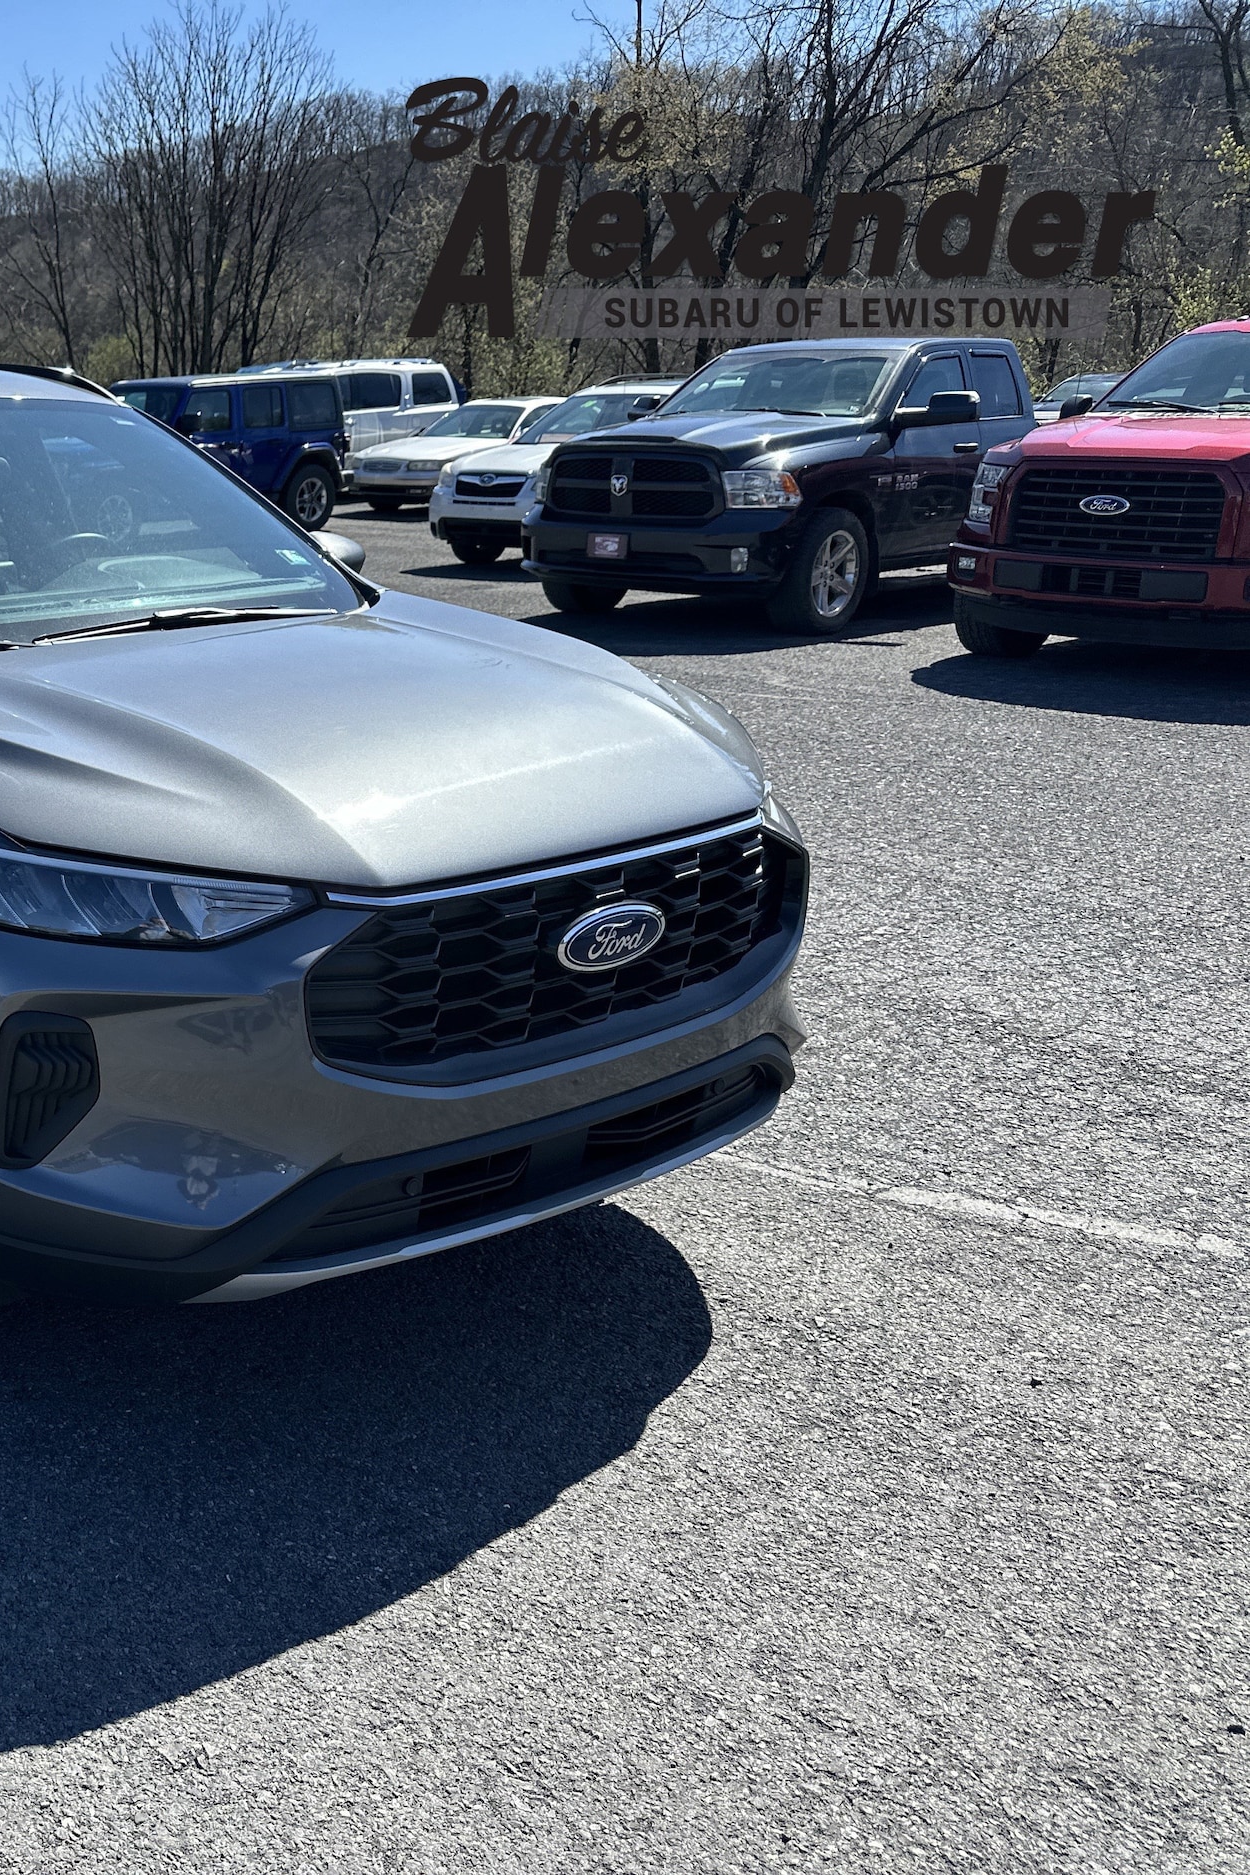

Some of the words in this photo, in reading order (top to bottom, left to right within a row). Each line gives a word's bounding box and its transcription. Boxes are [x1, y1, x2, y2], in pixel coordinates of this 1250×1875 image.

[896, 474, 919, 483] RAM
[895, 481, 918, 491] 1500
[1088, 498, 1118, 511] Ford
[587, 919, 647, 961] Ford
